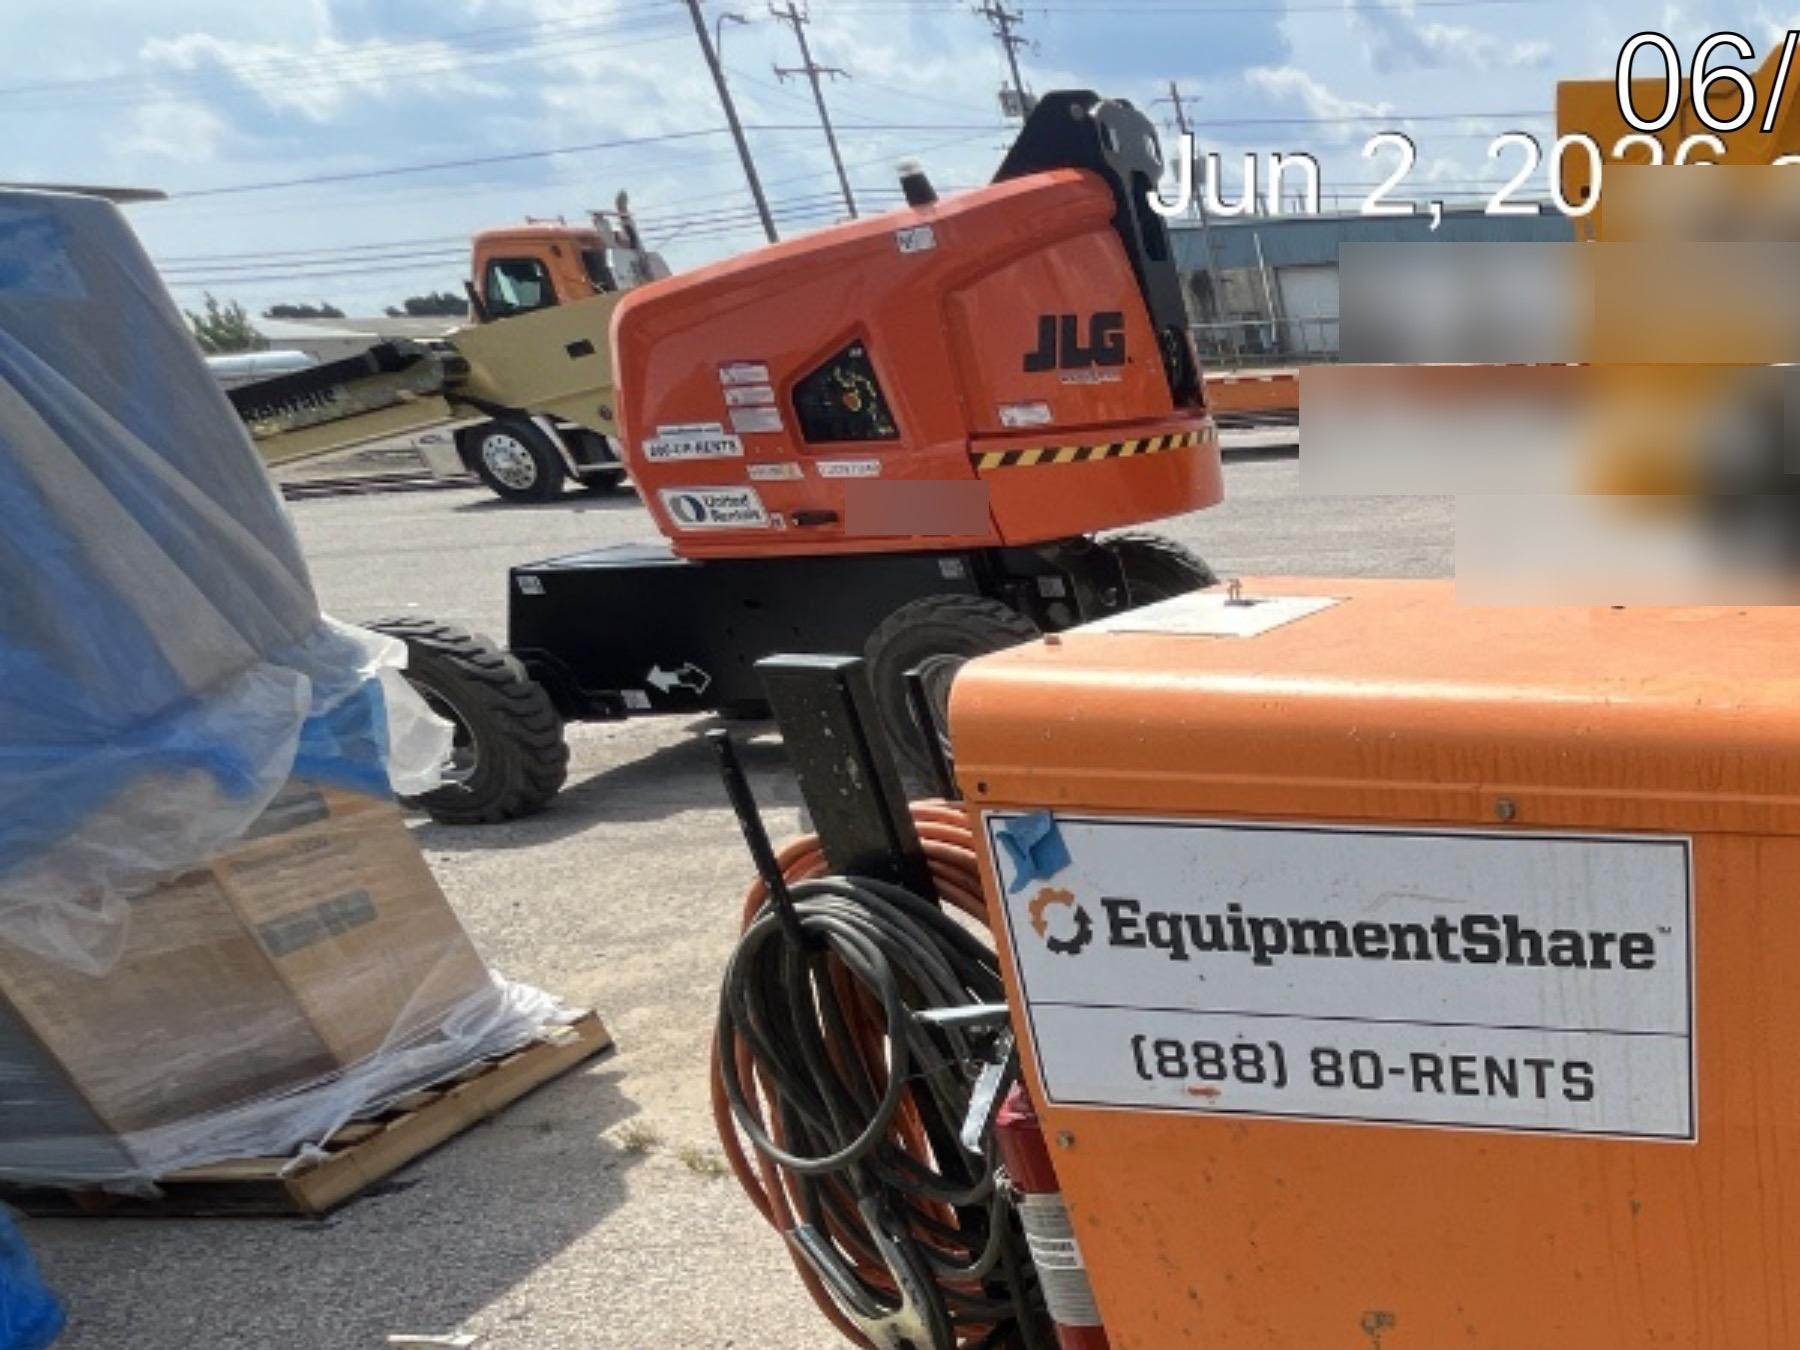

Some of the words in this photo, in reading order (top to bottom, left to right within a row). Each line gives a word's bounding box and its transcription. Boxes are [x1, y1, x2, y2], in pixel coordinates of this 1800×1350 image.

[1023, 311, 1126, 372] JLG
[1130, 1034, 1288, 1088] (888)
[1310, 1048, 1596, 1102] 80-RENTS
